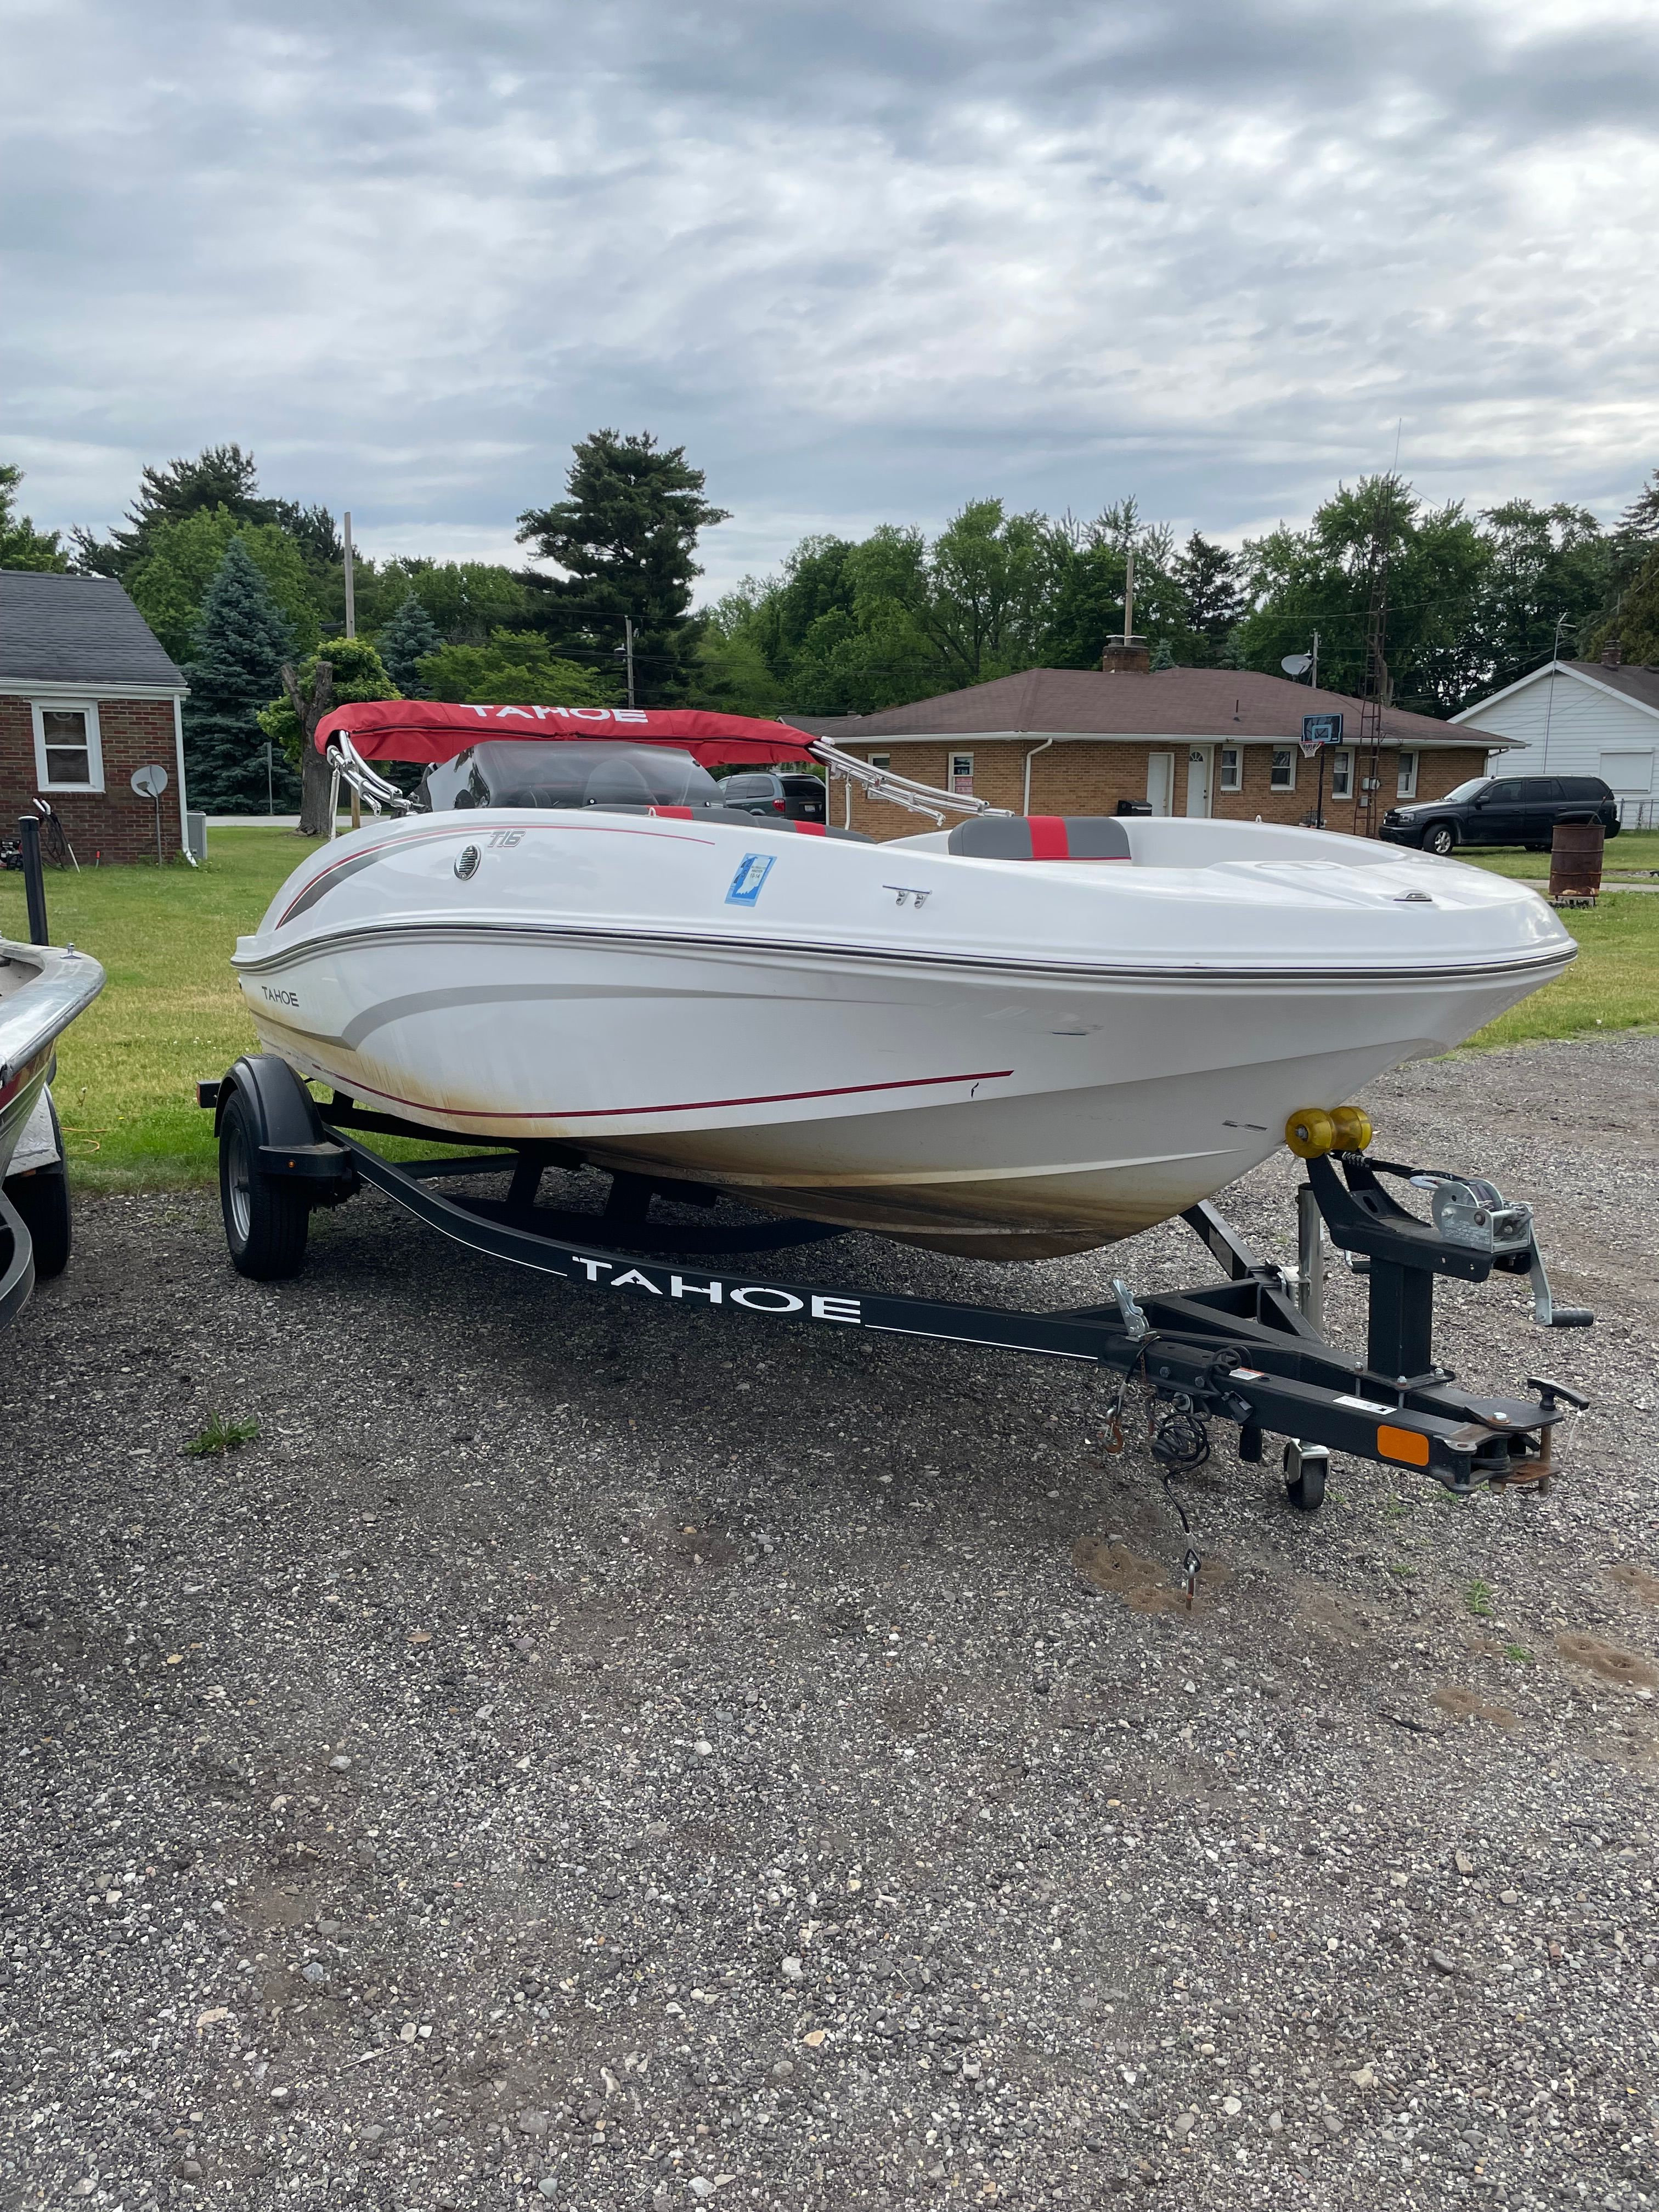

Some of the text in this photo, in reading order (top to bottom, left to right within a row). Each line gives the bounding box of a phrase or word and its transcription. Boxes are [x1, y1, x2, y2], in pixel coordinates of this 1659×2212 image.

[460, 704, 648, 723] TAHOE
[487, 829, 527, 848] T16
[262, 986, 300, 1007] TAHOE
[572, 1256, 861, 1323] TAHOE
